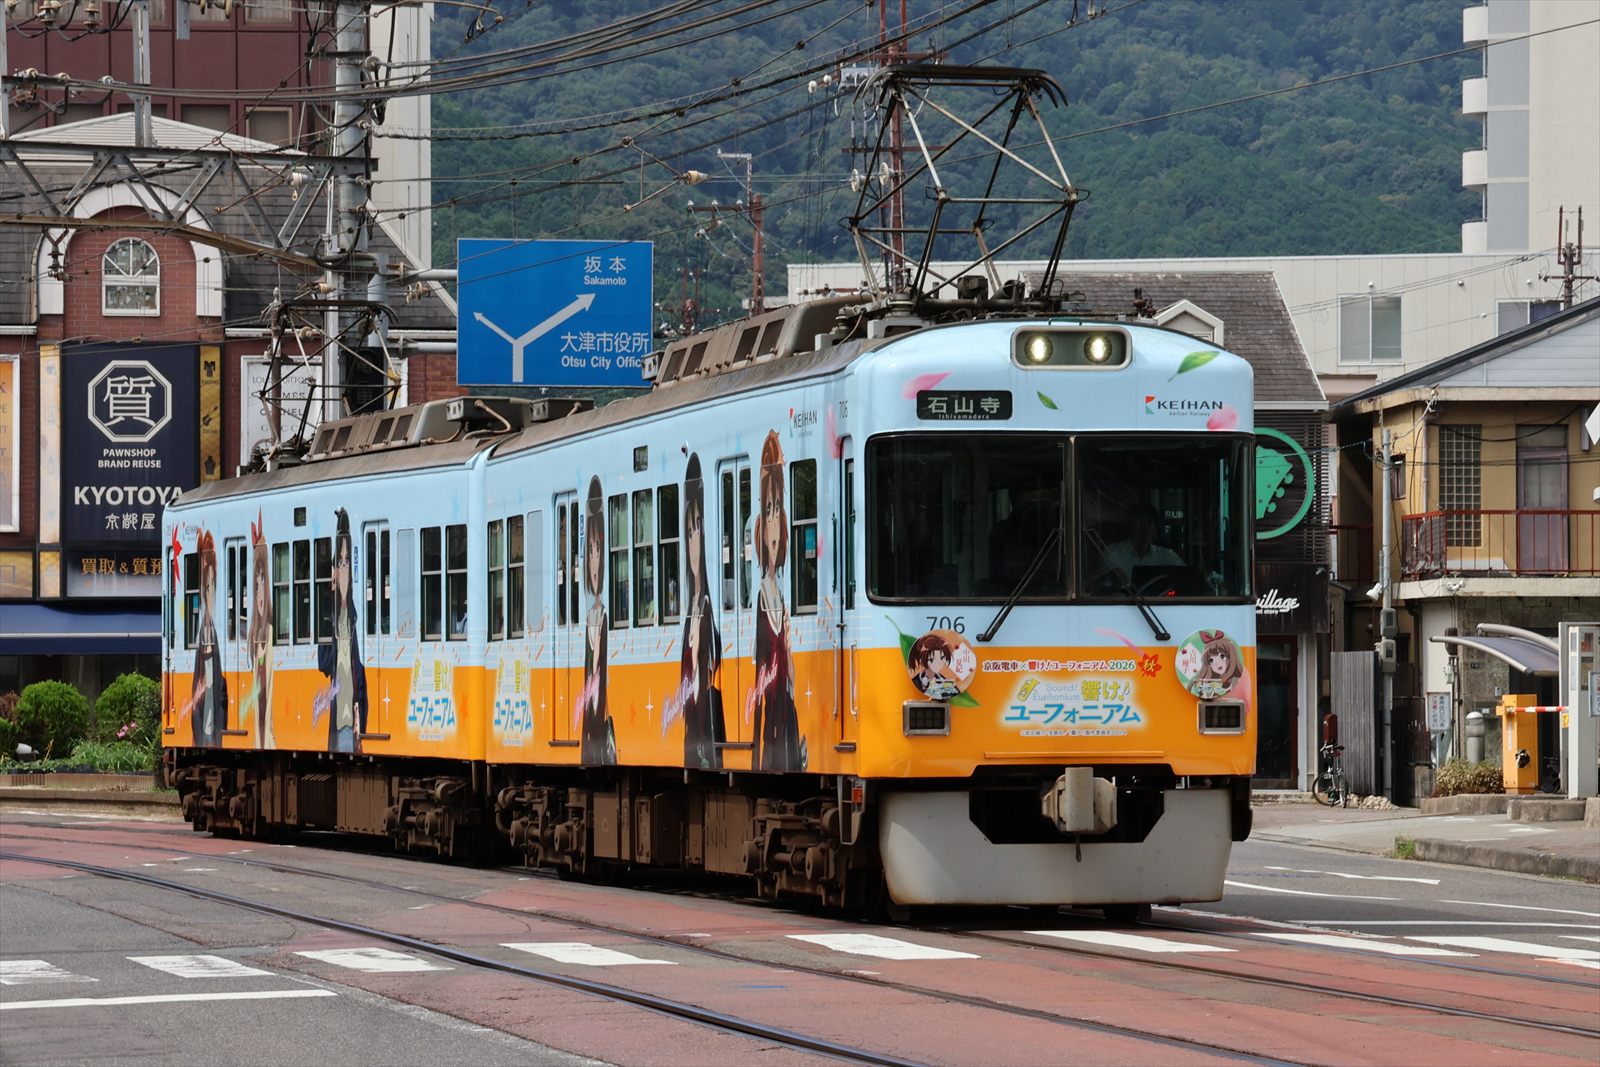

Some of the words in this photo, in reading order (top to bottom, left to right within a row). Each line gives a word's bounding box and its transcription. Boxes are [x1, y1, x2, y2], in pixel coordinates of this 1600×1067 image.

[584, 256, 626, 274] 坂本
[584, 275, 626, 285] Sakamoto
[560, 331, 649, 353] 大津市役所
[561, 355, 586, 367] Otsu
[591, 356, 611, 370] City
[616, 356, 642, 368] Offic
[103, 375, 156, 427] 質
[928, 397, 1000, 413] 石山寺
[1157, 399, 1223, 410] KEIHAN
[794, 410, 818, 428] KEIHAN
[103, 449, 156, 457] PAWNSHOP
[98, 460, 130, 468] BRAND
[132, 460, 162, 468] REUSE
[105, 513, 155, 530] 京都屋
[926, 616, 965, 634] 706
[1032, 692, 1080, 701] Euphonium
[1005, 703, 1141, 724] ユーフォニアム
